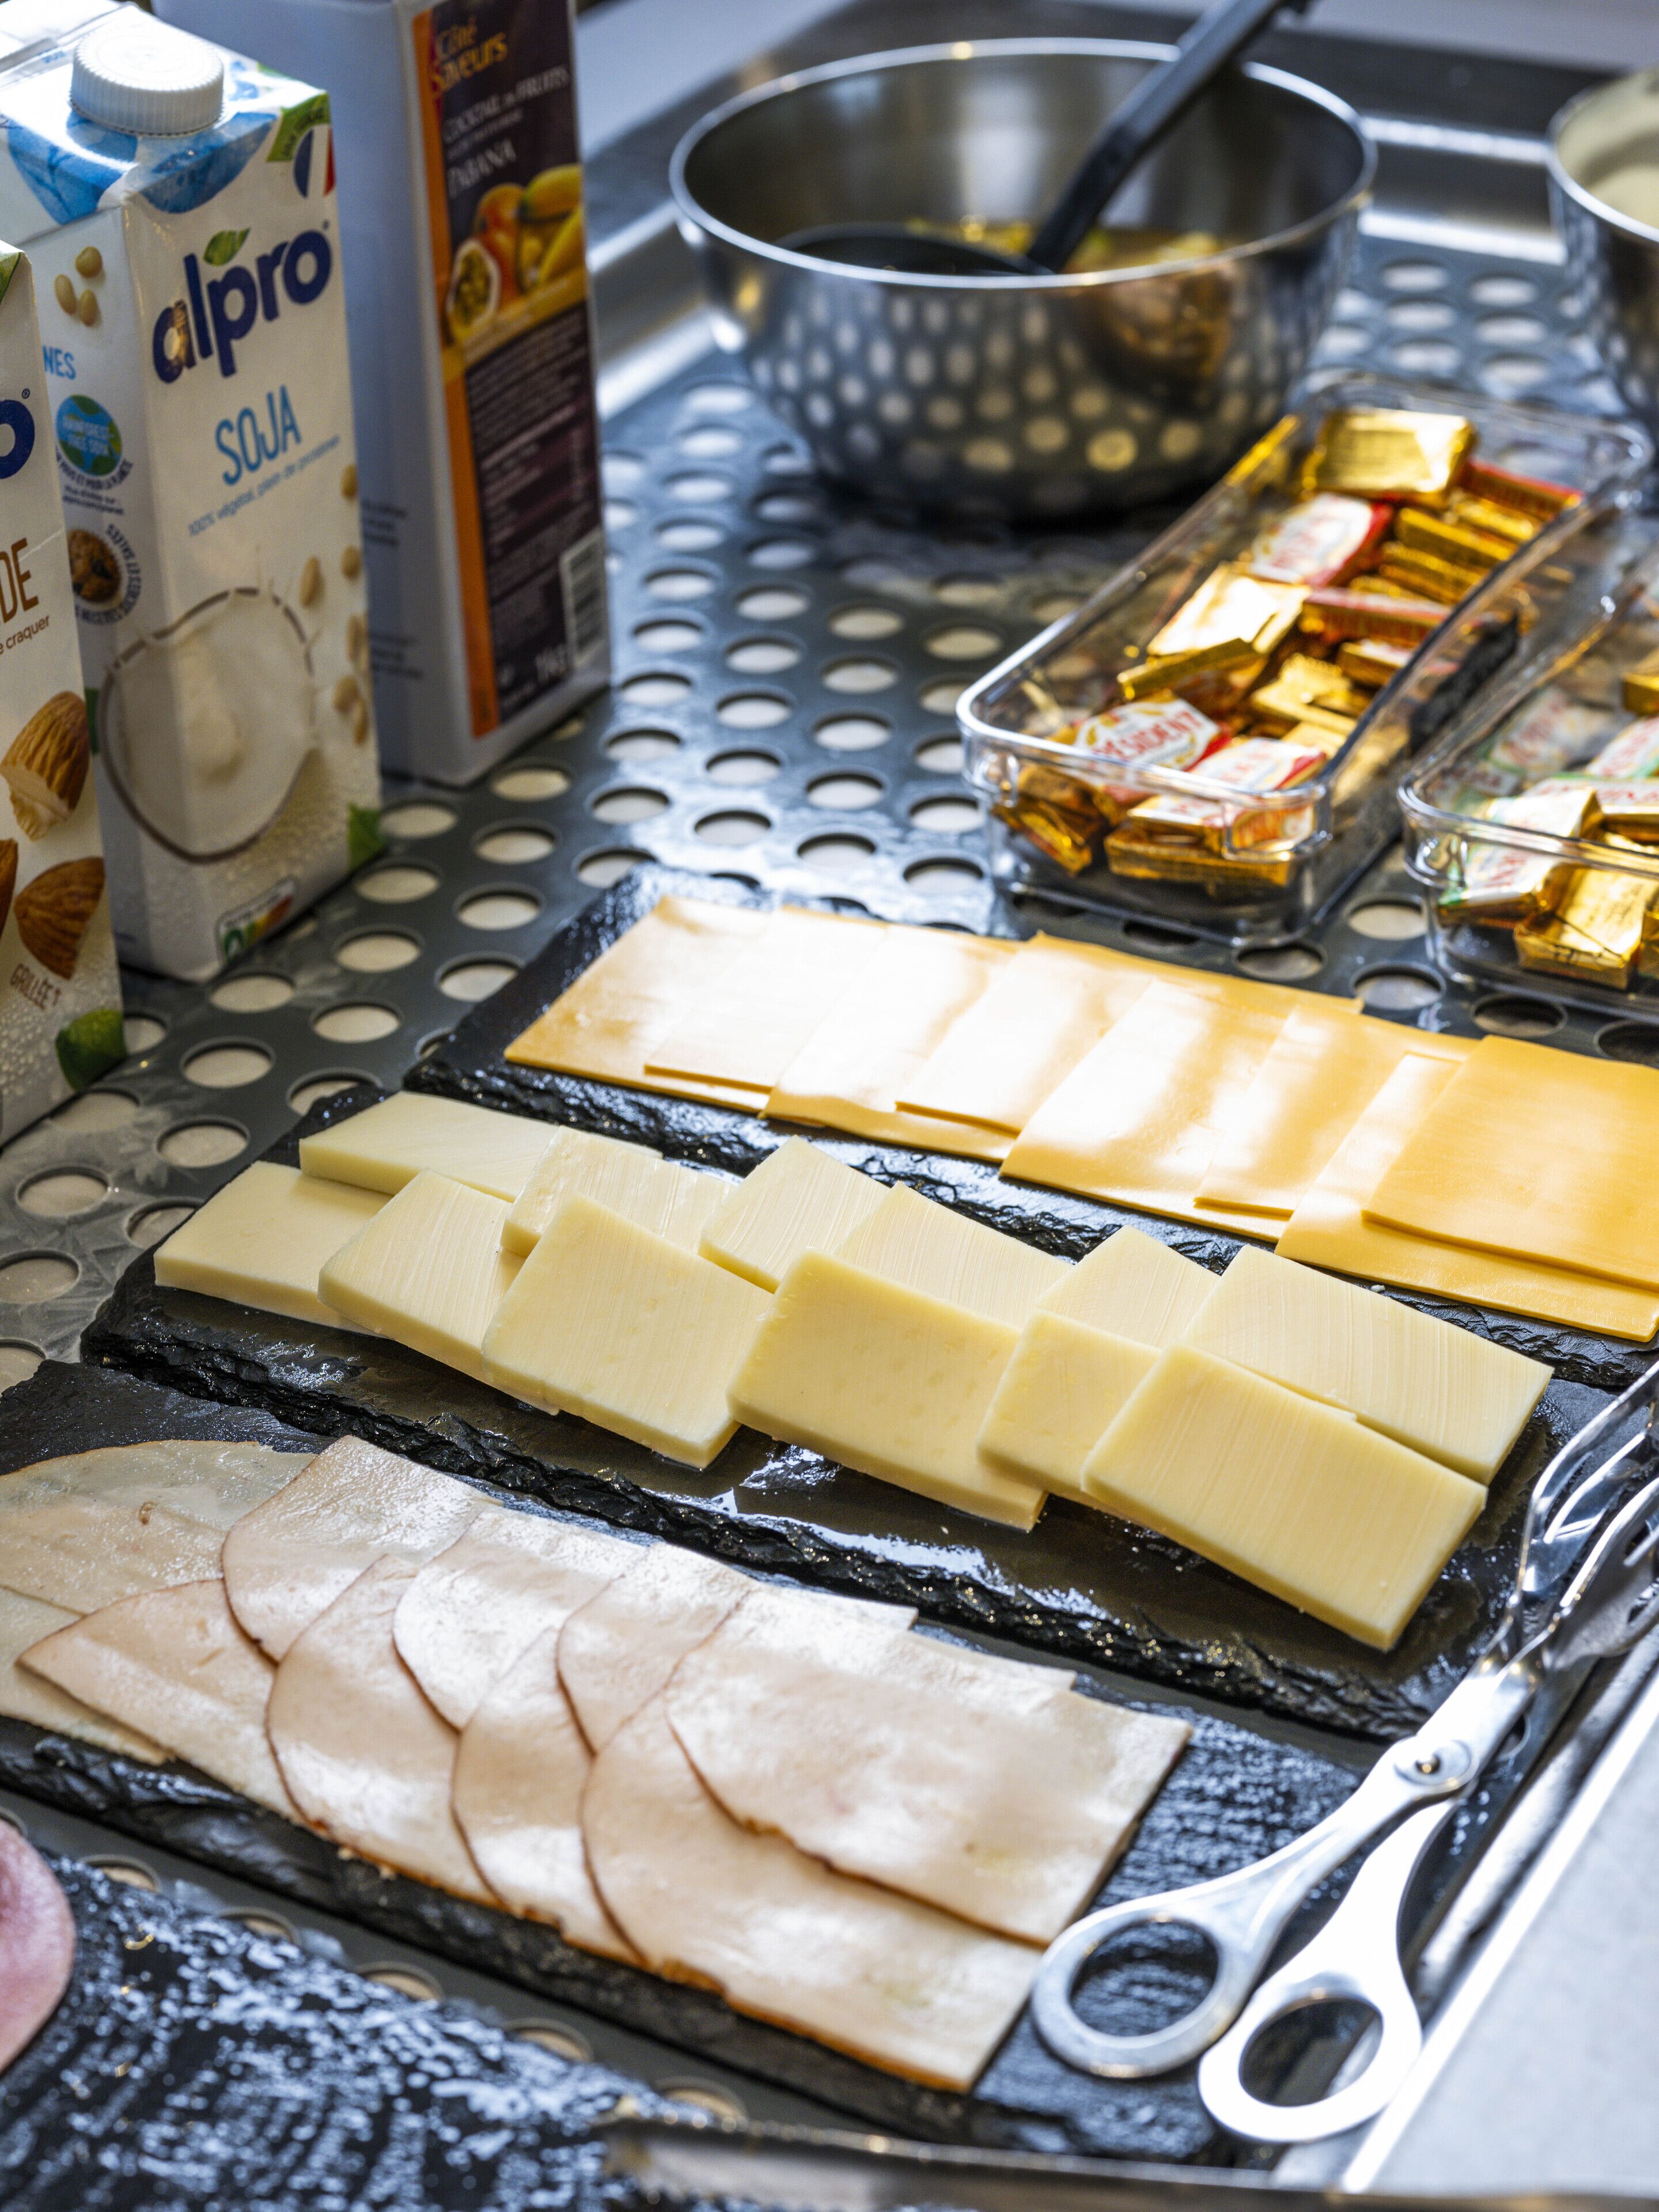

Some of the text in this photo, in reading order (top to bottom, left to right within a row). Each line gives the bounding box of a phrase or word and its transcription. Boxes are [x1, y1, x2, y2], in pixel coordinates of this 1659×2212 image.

[152, 229, 332, 384] alpro
[42, 346, 76, 380] NES
[214, 383, 301, 487] SOJA
[0, 537, 39, 624] DE
[6, 614, 50, 650] craquer
